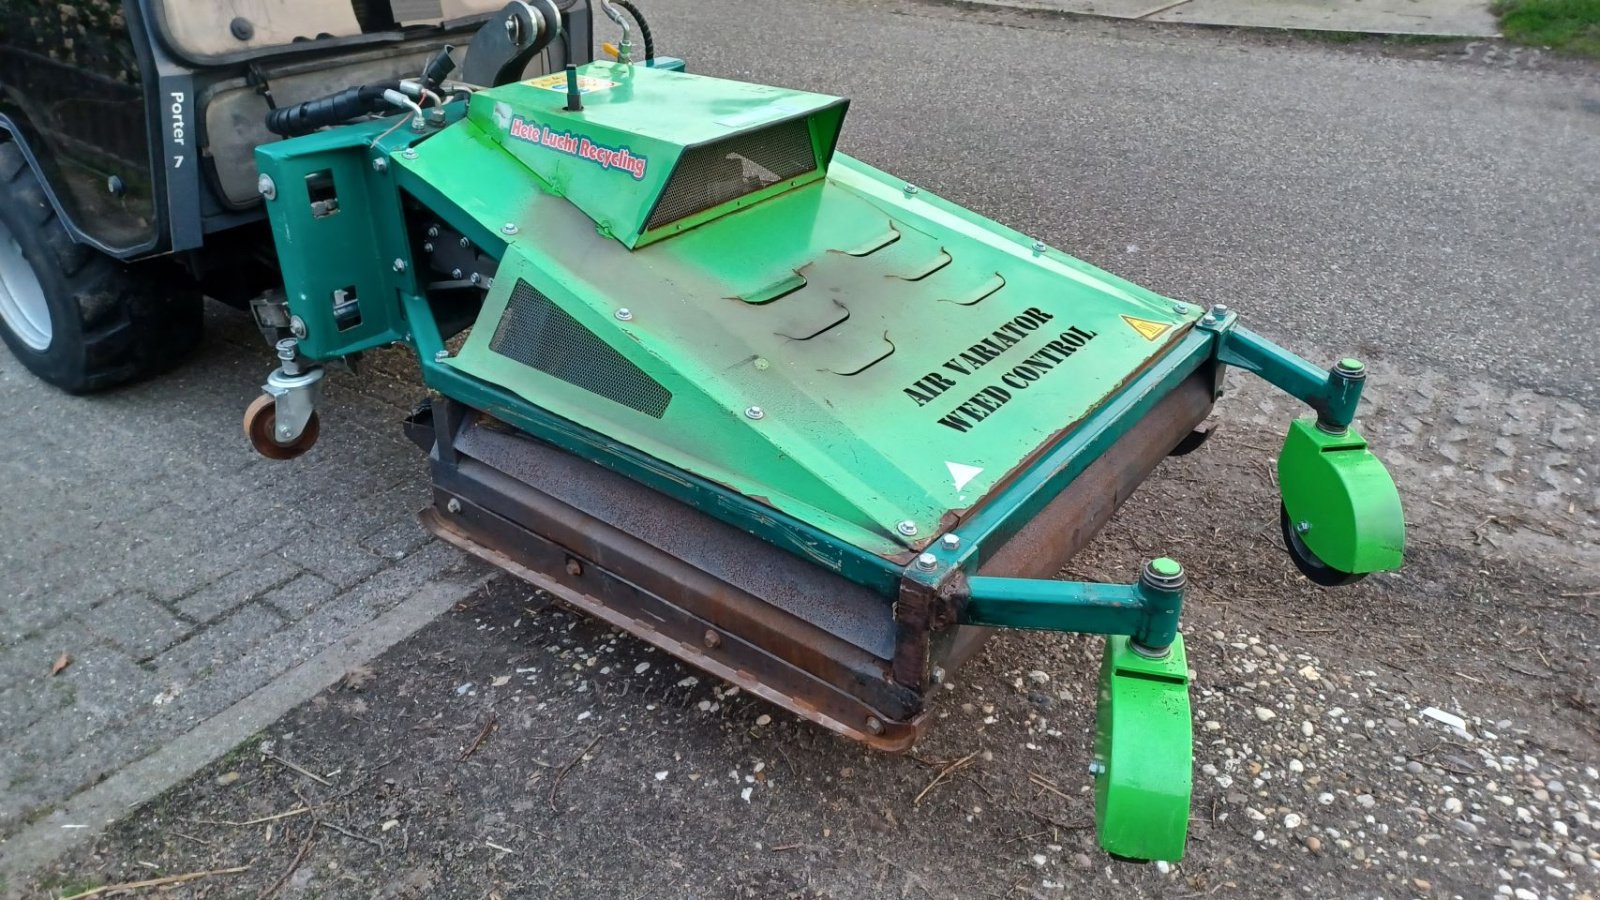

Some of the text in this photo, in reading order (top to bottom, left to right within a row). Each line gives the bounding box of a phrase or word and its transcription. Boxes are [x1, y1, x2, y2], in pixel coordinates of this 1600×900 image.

[170, 92, 185, 168] Porter 7
[510, 118, 646, 178] Hete Lucht Recycling
[902, 307, 1054, 408] AIR VARIATOR
[937, 325, 1098, 433] WEED CONTROL
